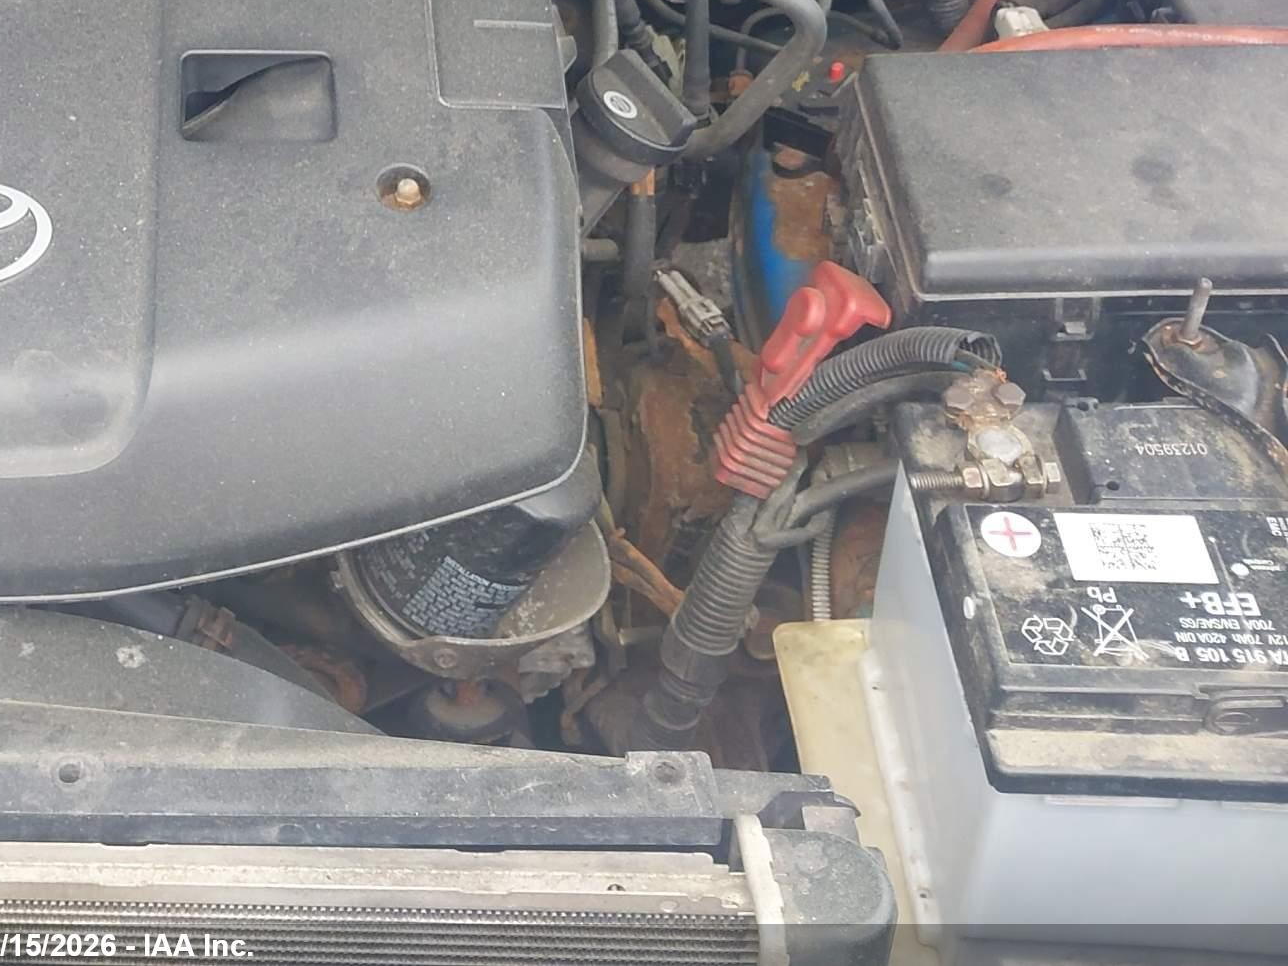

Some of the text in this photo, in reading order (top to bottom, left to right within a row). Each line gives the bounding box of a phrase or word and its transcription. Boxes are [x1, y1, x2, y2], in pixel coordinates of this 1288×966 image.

[1086, 586, 1118, 603] Pb
[1178, 591, 1262, 616] EFB+
[1243, 619, 1276, 631] 700A
[1174, 631, 1197, 643] DIN
[1196, 632, 1227, 644] 420A
[1232, 633, 1264, 645] 70Ah
[1174, 646, 1191, 662] B
[1196, 647, 1231, 663] 105
[1232, 648, 1268, 665] 915
